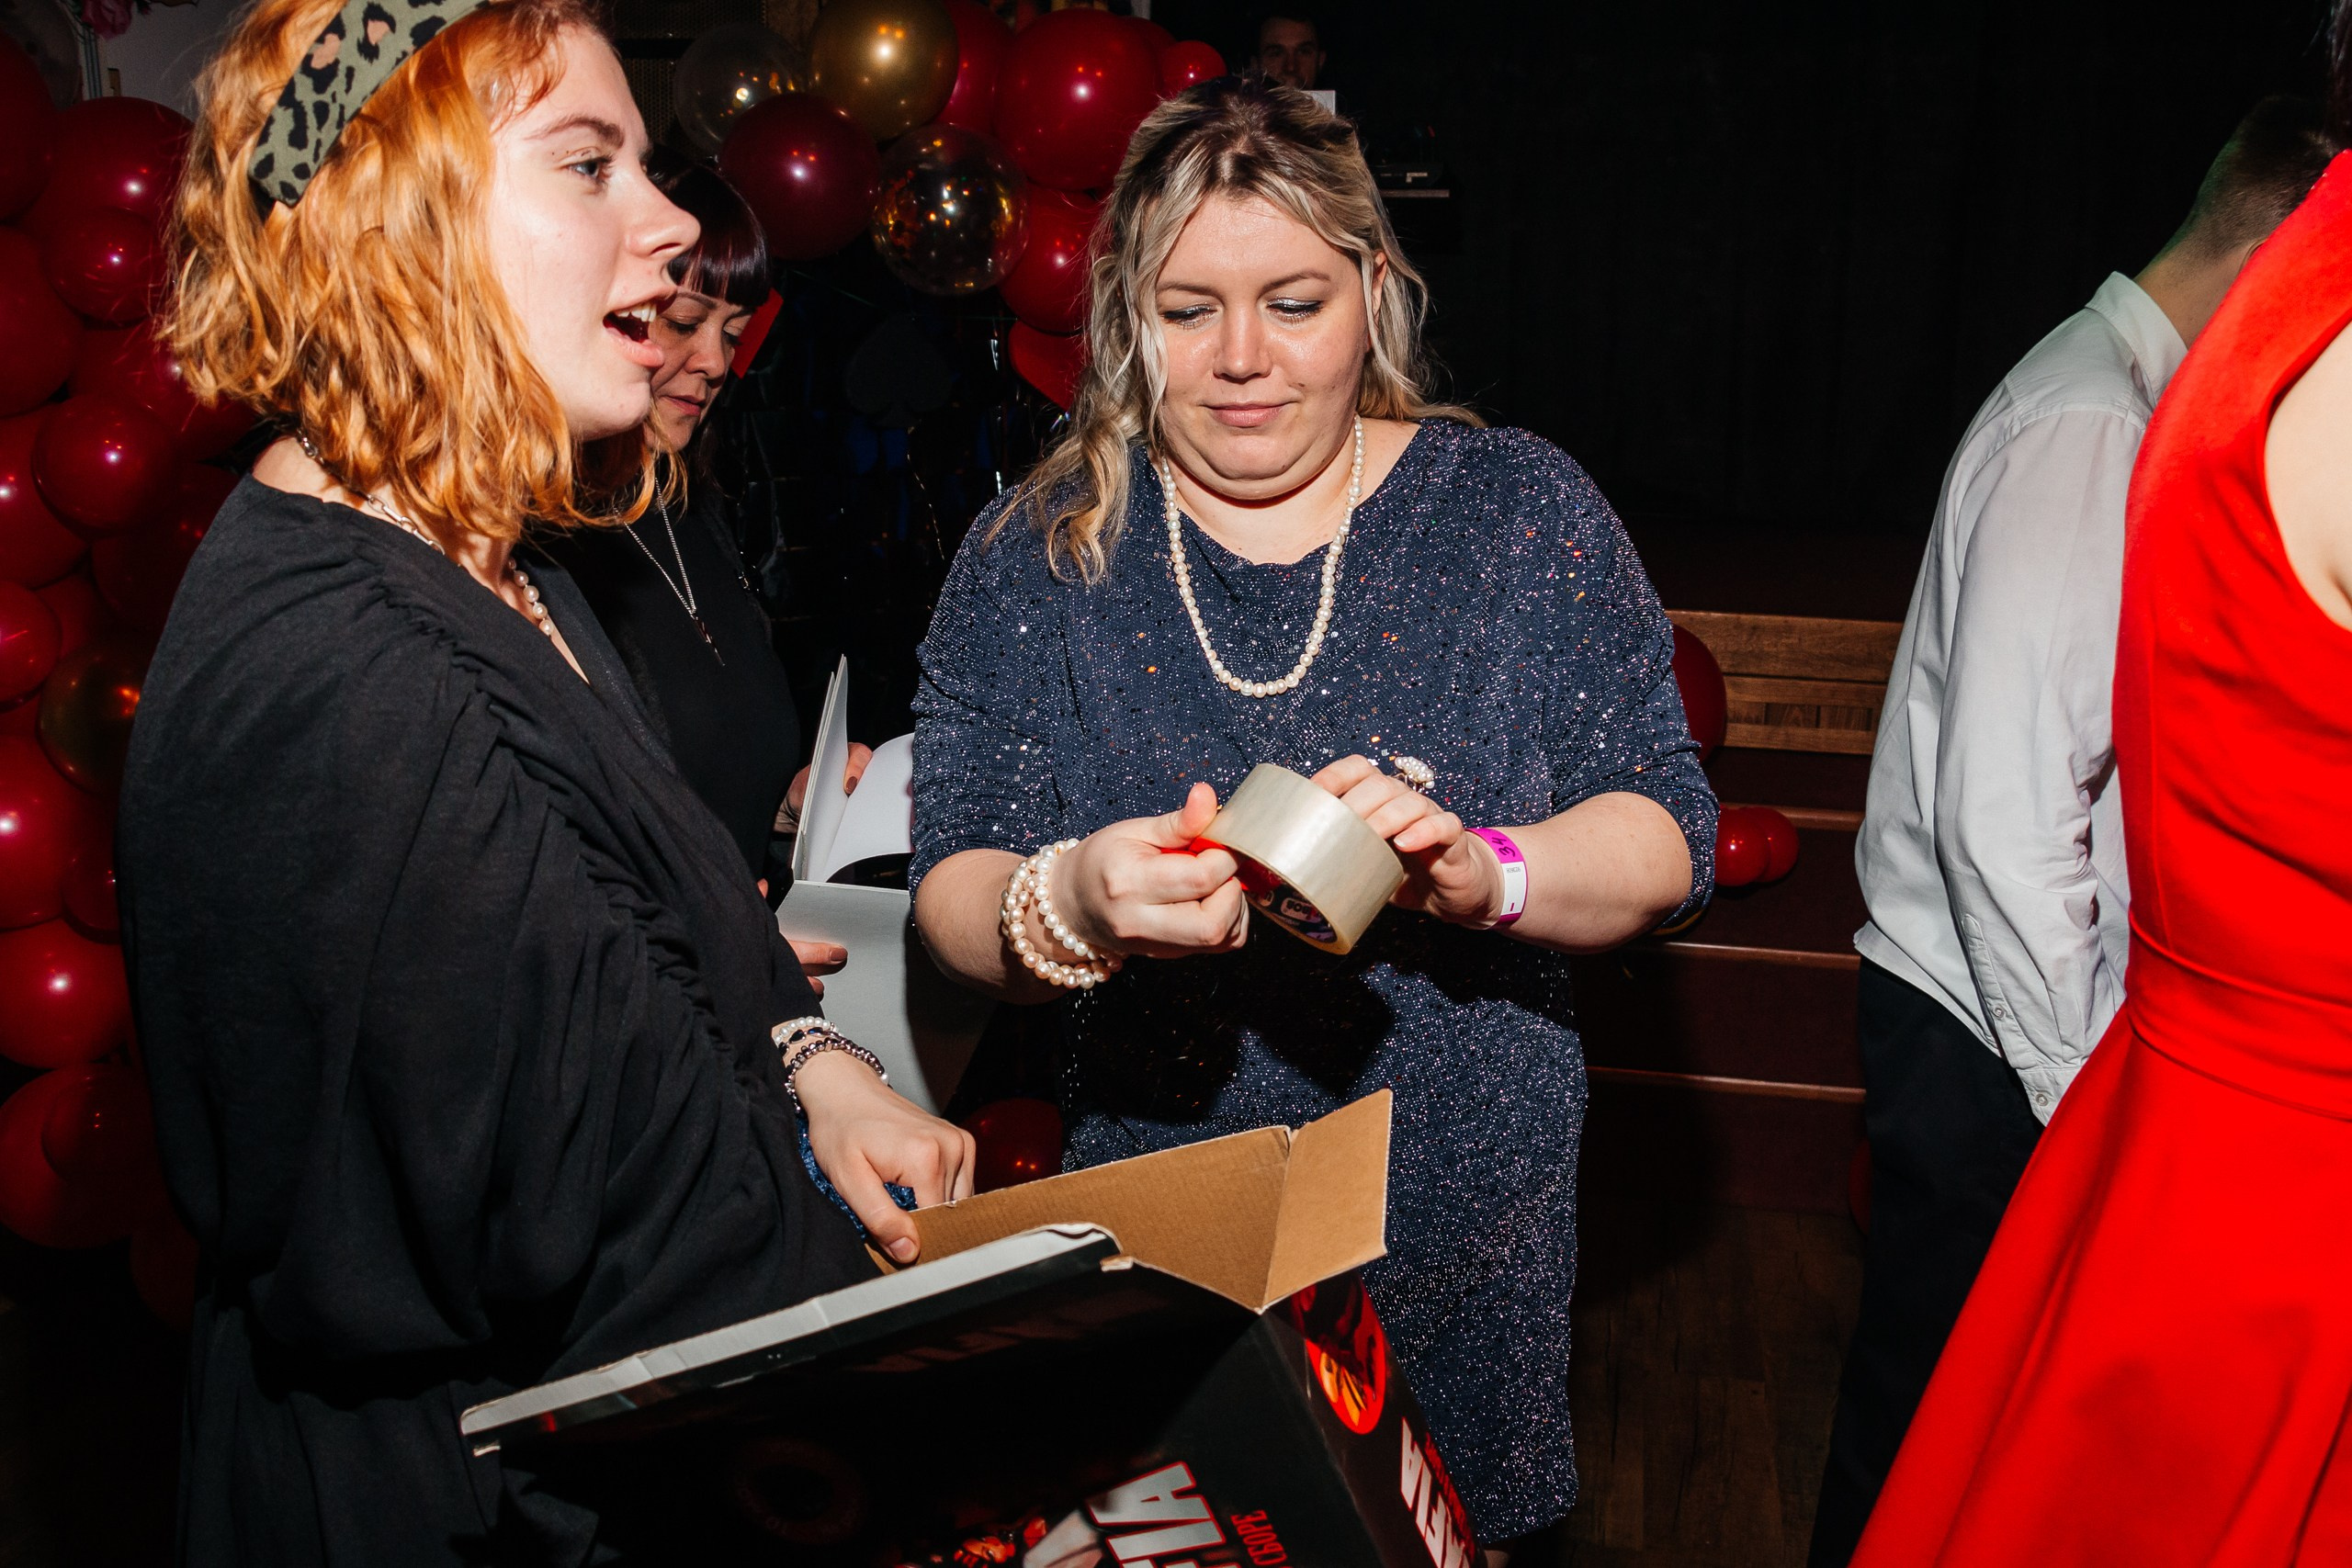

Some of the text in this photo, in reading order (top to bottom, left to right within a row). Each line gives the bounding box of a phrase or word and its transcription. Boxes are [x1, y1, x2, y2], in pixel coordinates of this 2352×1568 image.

[1491, 837, 1516, 857] 34
[1400, 1416, 1470, 1568] AFIA
[1230, 1510, 1288, 1565] СБОРЕ
